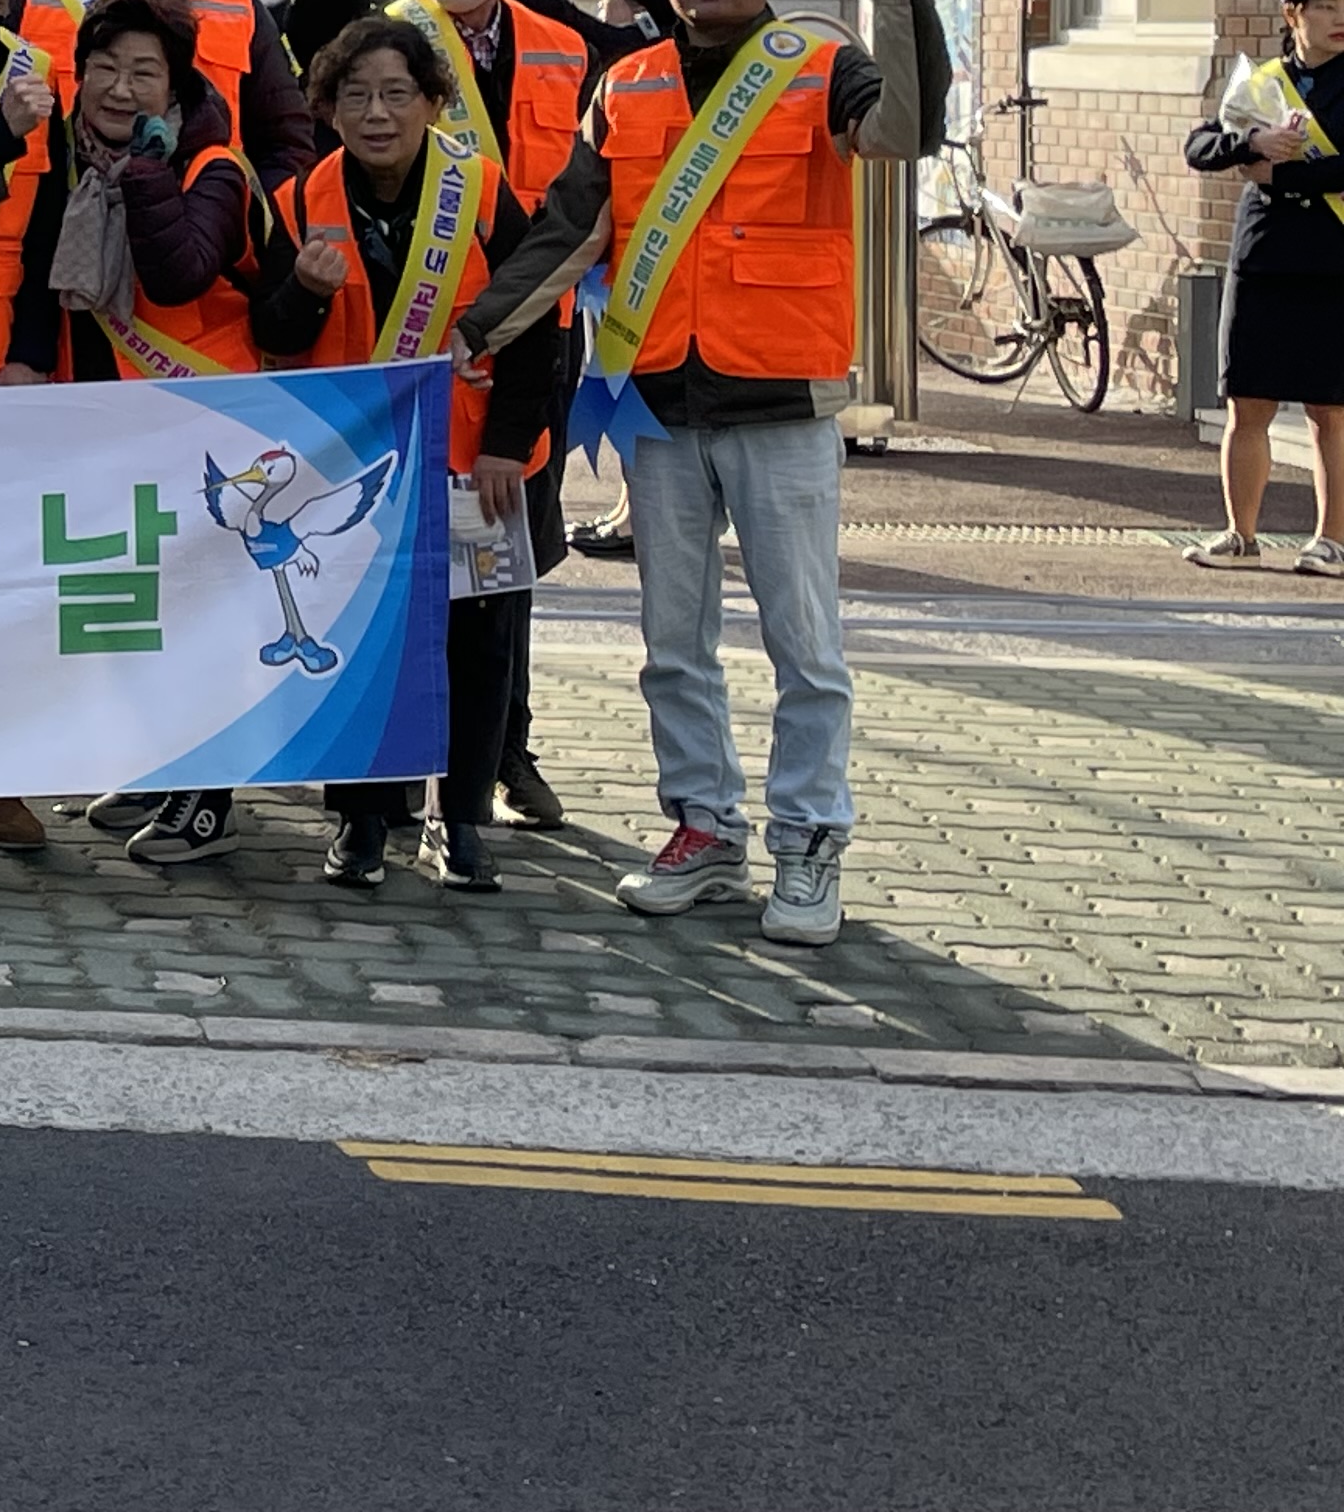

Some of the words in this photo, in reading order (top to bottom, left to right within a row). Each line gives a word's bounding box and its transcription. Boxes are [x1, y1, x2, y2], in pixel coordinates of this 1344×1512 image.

[711, 60, 773, 140] 안전한
[626, 226, 670, 311] 만들기
[40, 483, 177, 656] 날
